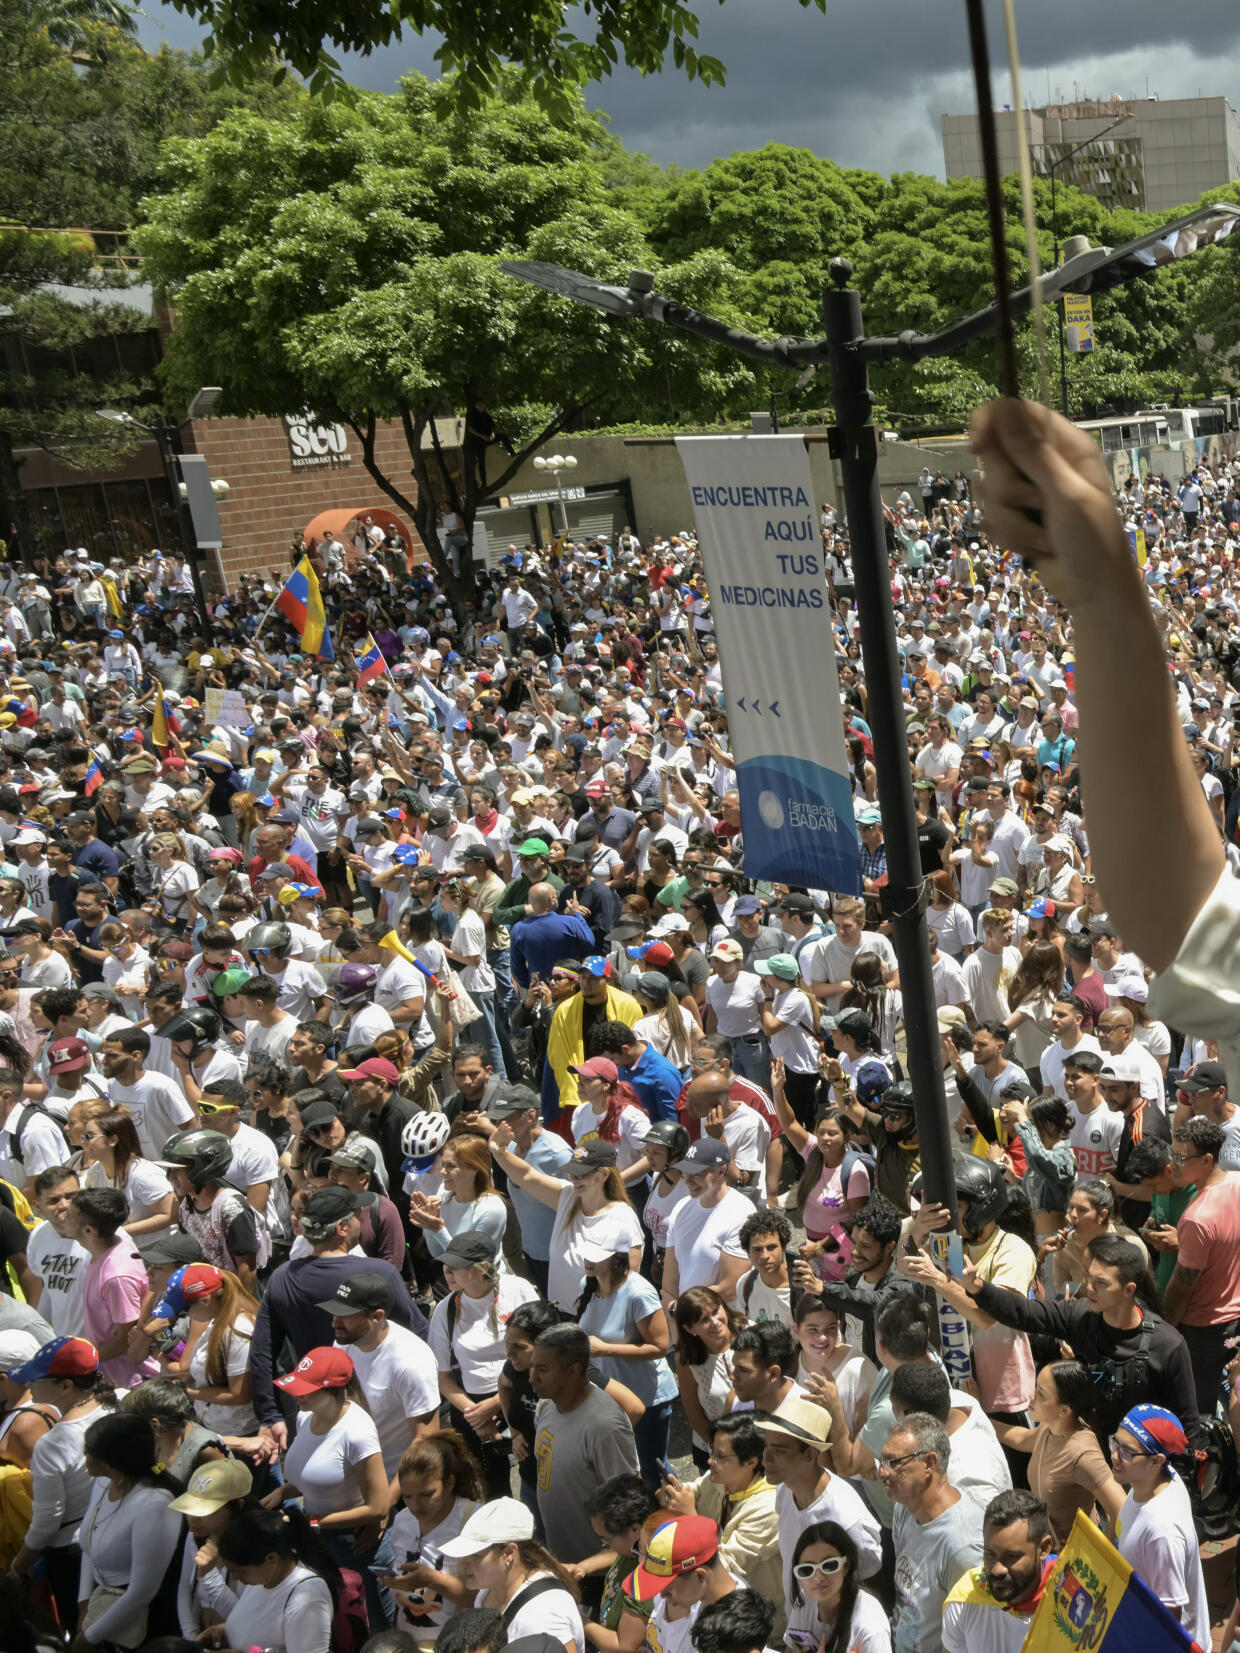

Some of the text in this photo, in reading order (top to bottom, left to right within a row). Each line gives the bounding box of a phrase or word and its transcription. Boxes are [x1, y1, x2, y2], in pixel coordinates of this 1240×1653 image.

[1067, 314, 1092, 323] DAKA
[691, 486, 809, 507] ENCUENTRA
[764, 514, 814, 541] AQUÍ
[776, 554, 819, 575] TUS
[720, 585, 824, 609] MEDICINAS
[302, 805, 328, 821] END
[305, 796, 330, 811] THE
[788, 797, 835, 817] farmacia
[41, 1253, 80, 1276] STAY
[47, 1274, 74, 1293] HOT
